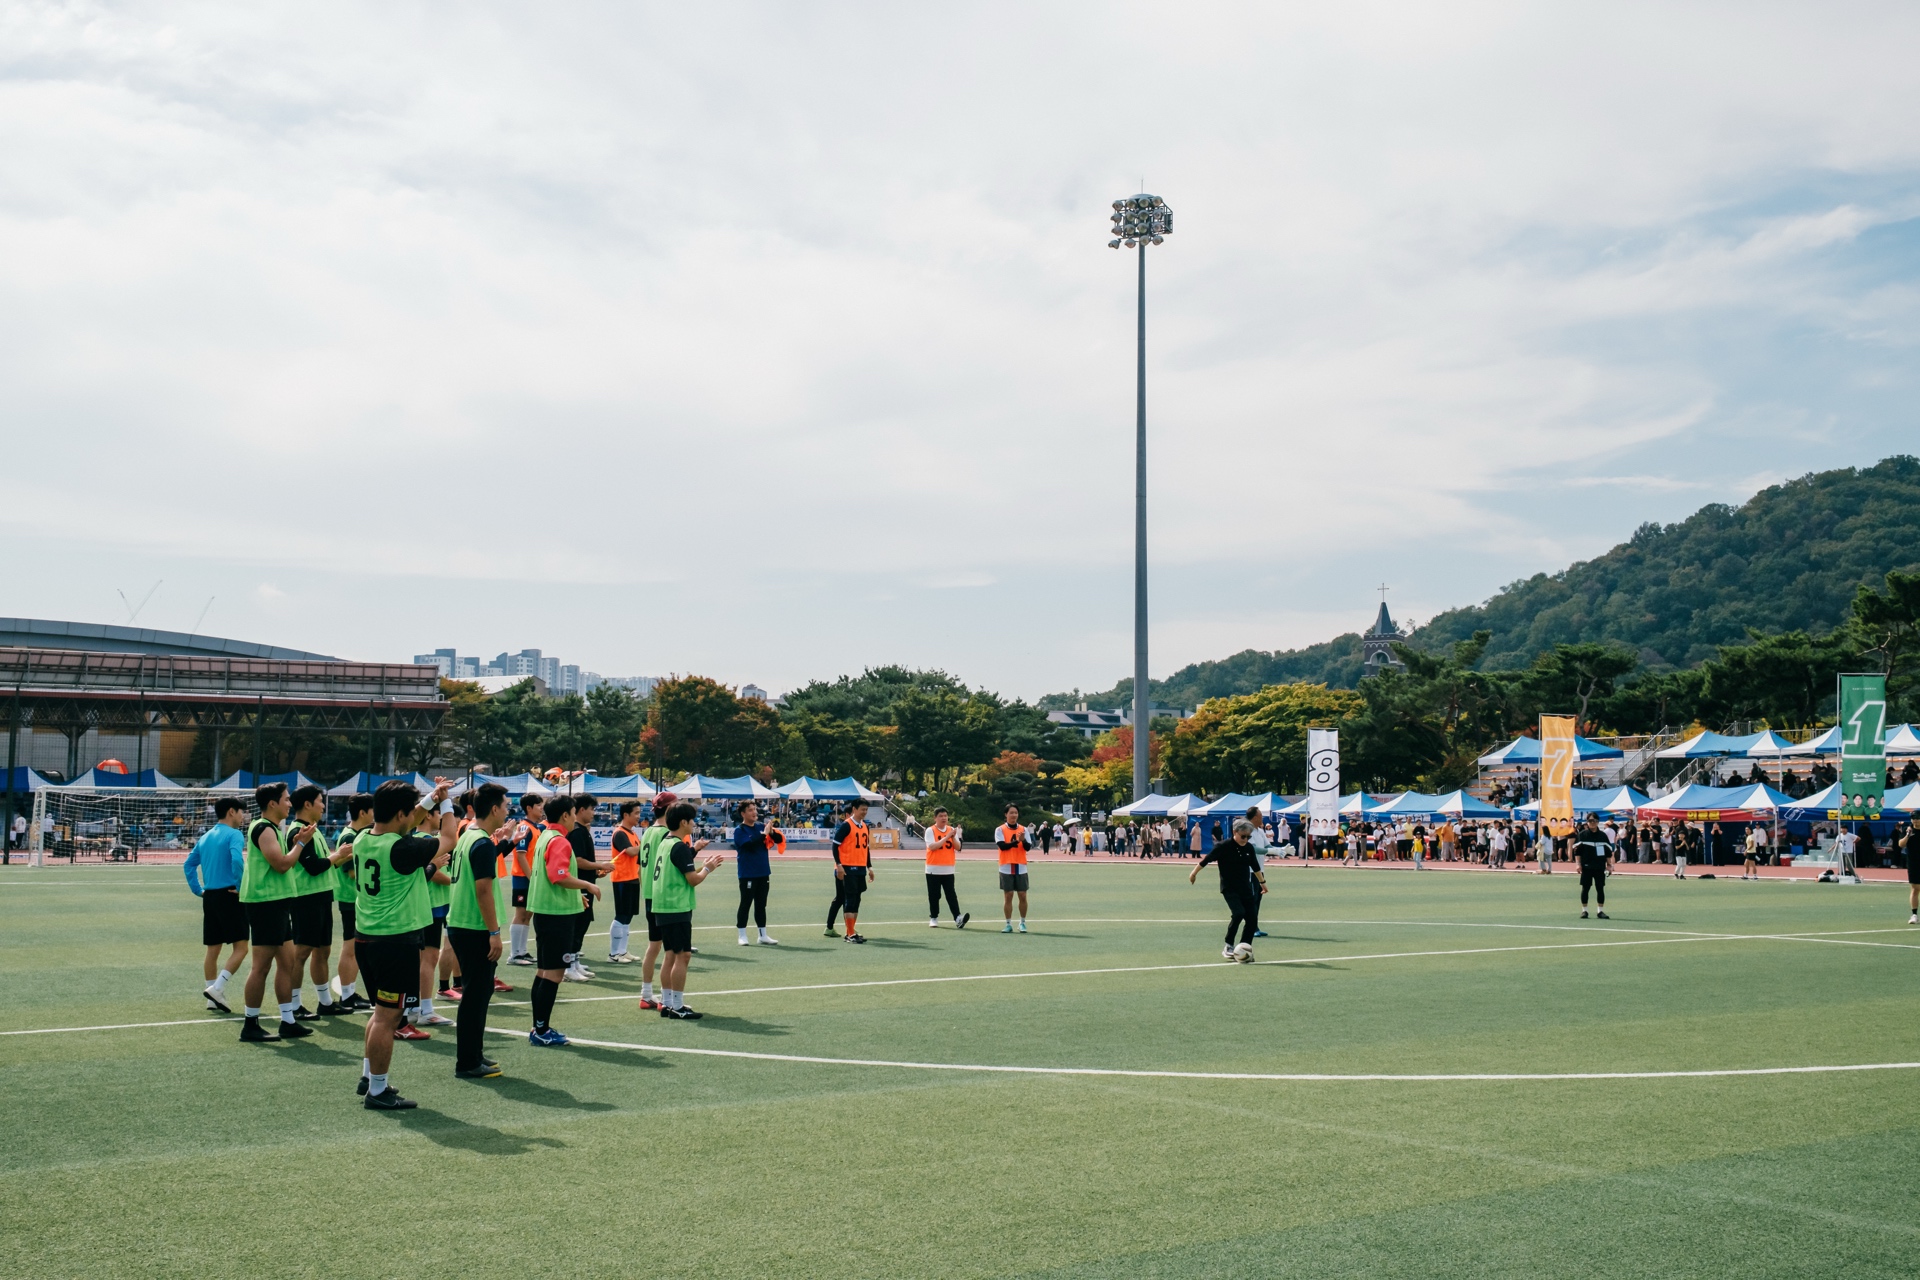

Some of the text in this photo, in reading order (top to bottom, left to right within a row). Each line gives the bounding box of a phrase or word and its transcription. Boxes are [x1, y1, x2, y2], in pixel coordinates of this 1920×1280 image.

[1841, 700, 1886, 759] 1
[1308, 749, 1340, 792] 8
[1541, 737, 1575, 788] 7
[855, 832, 868, 849] 13
[354, 854, 381, 897] 13
[653, 855, 663, 881] 6
